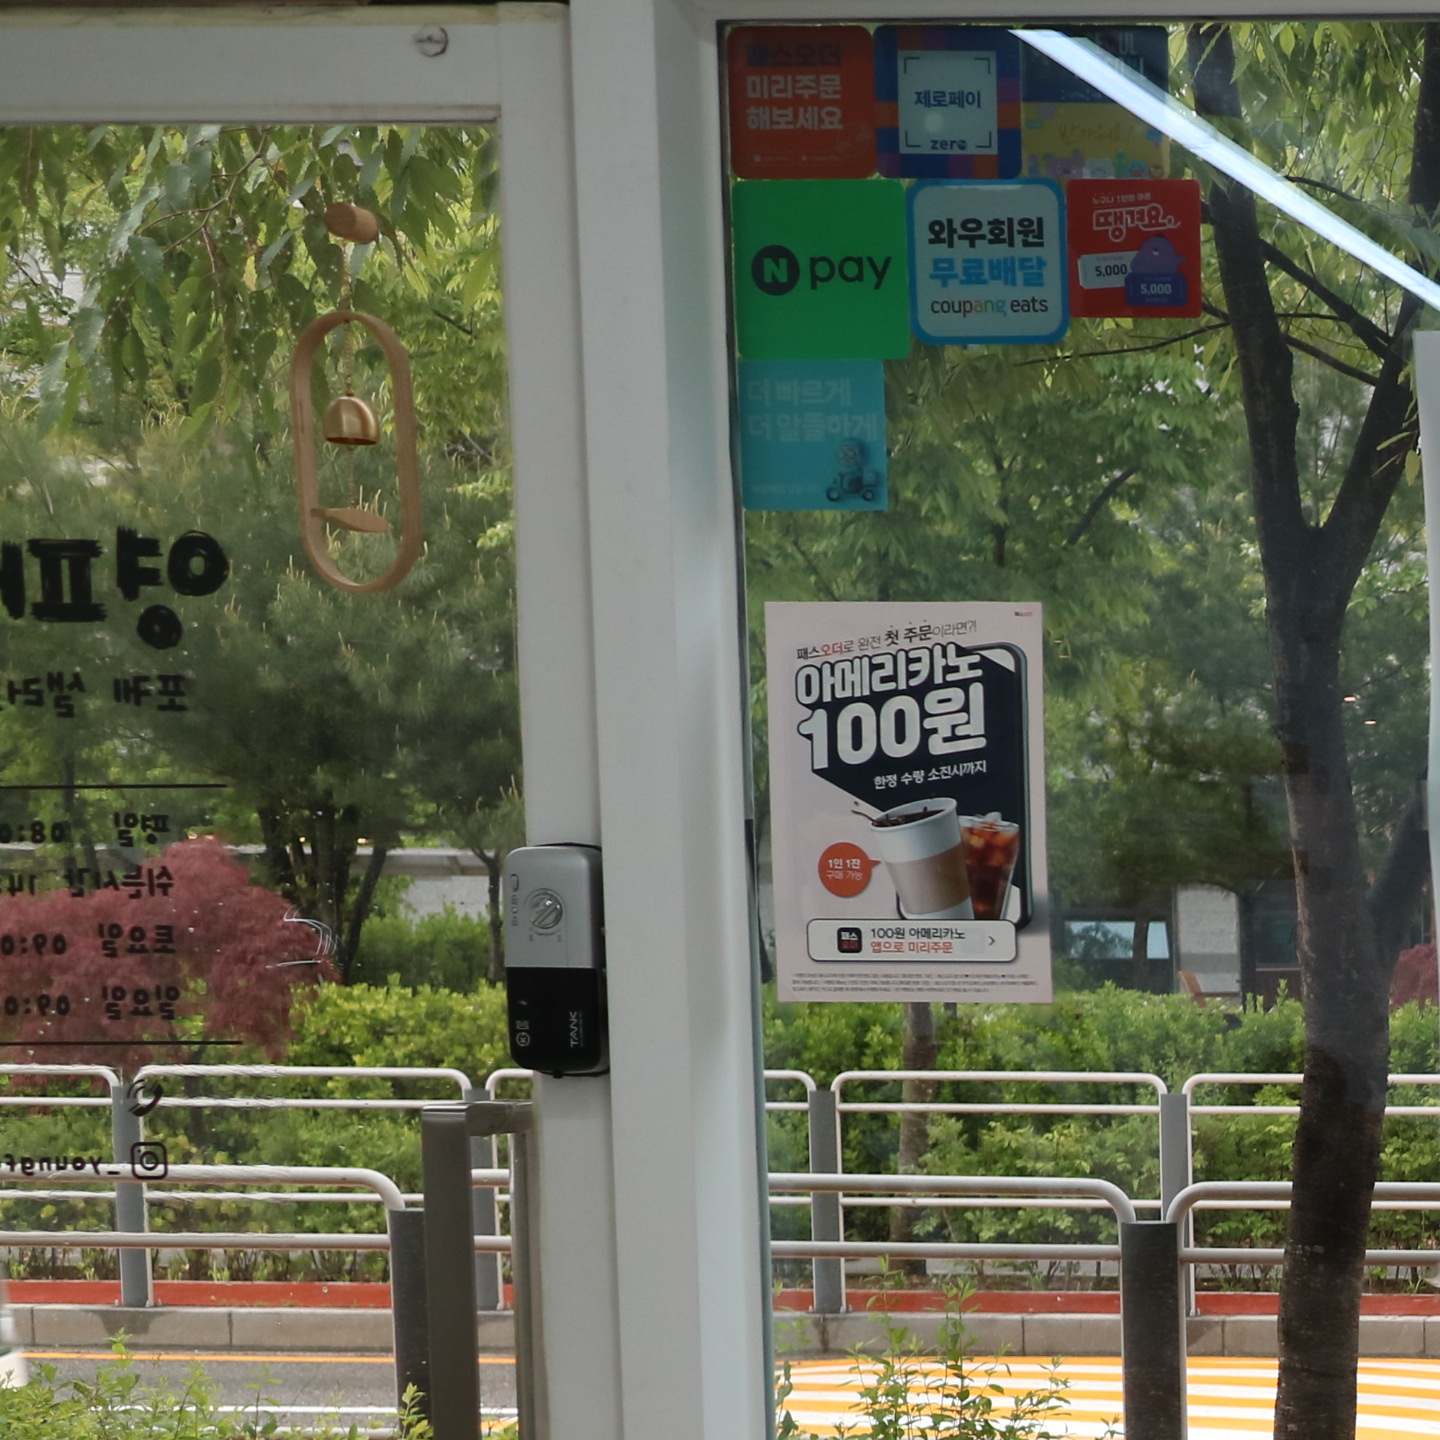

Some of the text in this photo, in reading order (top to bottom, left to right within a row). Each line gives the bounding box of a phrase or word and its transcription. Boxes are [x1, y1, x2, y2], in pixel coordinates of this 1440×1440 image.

[747, 74, 842, 99] 미리주문
[914, 90, 981, 108] 제로페이
[747, 106, 844, 130] 해보세요
[930, 139, 968, 150] zero
[928, 217, 1046, 248] 와우회원
[809, 255, 892, 290] pay
[929, 255, 1048, 288] 무료배달
[1095, 264, 1128, 277] 5,000
[1140, 283, 1172, 295] 5,000
[930, 296, 1049, 317] coupang eats
[796, 640, 854, 660] 패스오더로
[885, 629, 899, 646] 첫
[796, 641, 983, 704] 아메리카노
[797, 682, 987, 769] 100원
[874, 760, 987, 789] 한정 수량 소진시까지
[870, 928, 966, 940] 100원 아메리카노
[870, 941, 954, 954] 앱으로 미리주문
[569, 1011, 580, 1048] TANK
